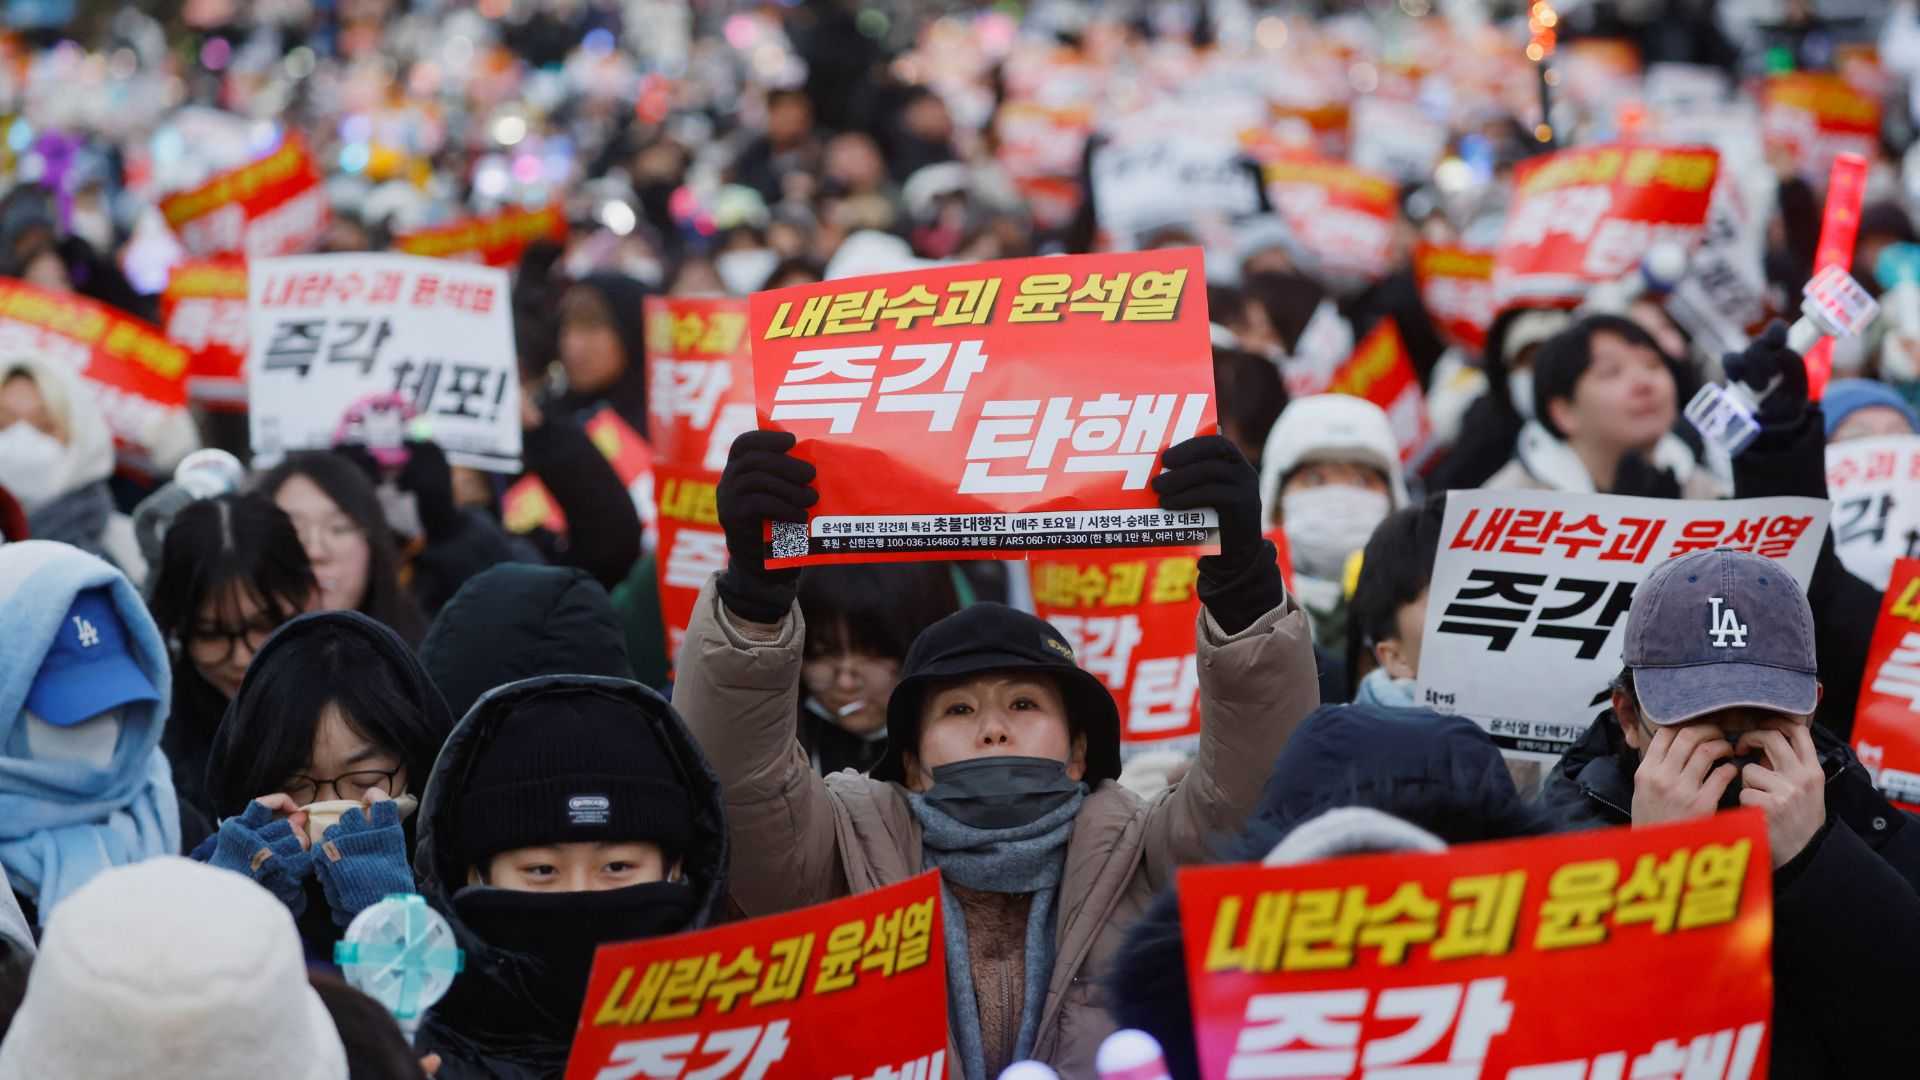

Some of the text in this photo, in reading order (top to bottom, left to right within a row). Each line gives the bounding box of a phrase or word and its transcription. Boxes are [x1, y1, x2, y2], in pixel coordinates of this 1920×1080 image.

[764, 268, 1190, 340] 내란수괴 윤석열
[263, 318, 393, 377] 즉각
[770, 340, 988, 434] 즉각
[957, 393, 1209, 495] 탄핵!
[821, 522, 852, 534] 윤석열
[855, 522, 875, 534] 퇴진
[878, 521, 908, 533] 김건희
[910, 521, 931, 534] 특검
[933, 515, 1007, 533] 촛불대행진
[1011, 517, 1040, 532] (매주
[1042, 516, 1077, 530] 토요일
[1087, 513, 1161, 529] 시청역-숭례문
[1163, 513, 1175, 526] 앞
[1177, 512, 1205, 527] 대로)
[821, 538, 841, 549] 후원
[848, 537, 885, 549] 신한은행
[887, 537, 959, 548] 100-036-164860
[1005, 535, 1025, 546] ARS
[1025, 533, 1088, 545] 060-707-3300
[1089, 533, 1103, 545] (한
[1124, 531, 1139, 544] 1만
[1140, 531, 1154, 545] 원,
[1155, 531, 1174, 543] 여러
[1175, 530, 1186, 542] 번
[1186, 530, 1209, 542] 가능)
[1448, 506, 1815, 565] 내란수괴 윤석열
[72, 615, 99, 648] LA
[1436, 567, 1638, 661] 즉각
[1708, 597, 1749, 648] LA
[1490, 719, 1530, 736] 윤석열
[1204, 838, 1752, 972] 내란수괴 윤석열
[593, 897, 935, 1026] 내란수괴 윤석열
